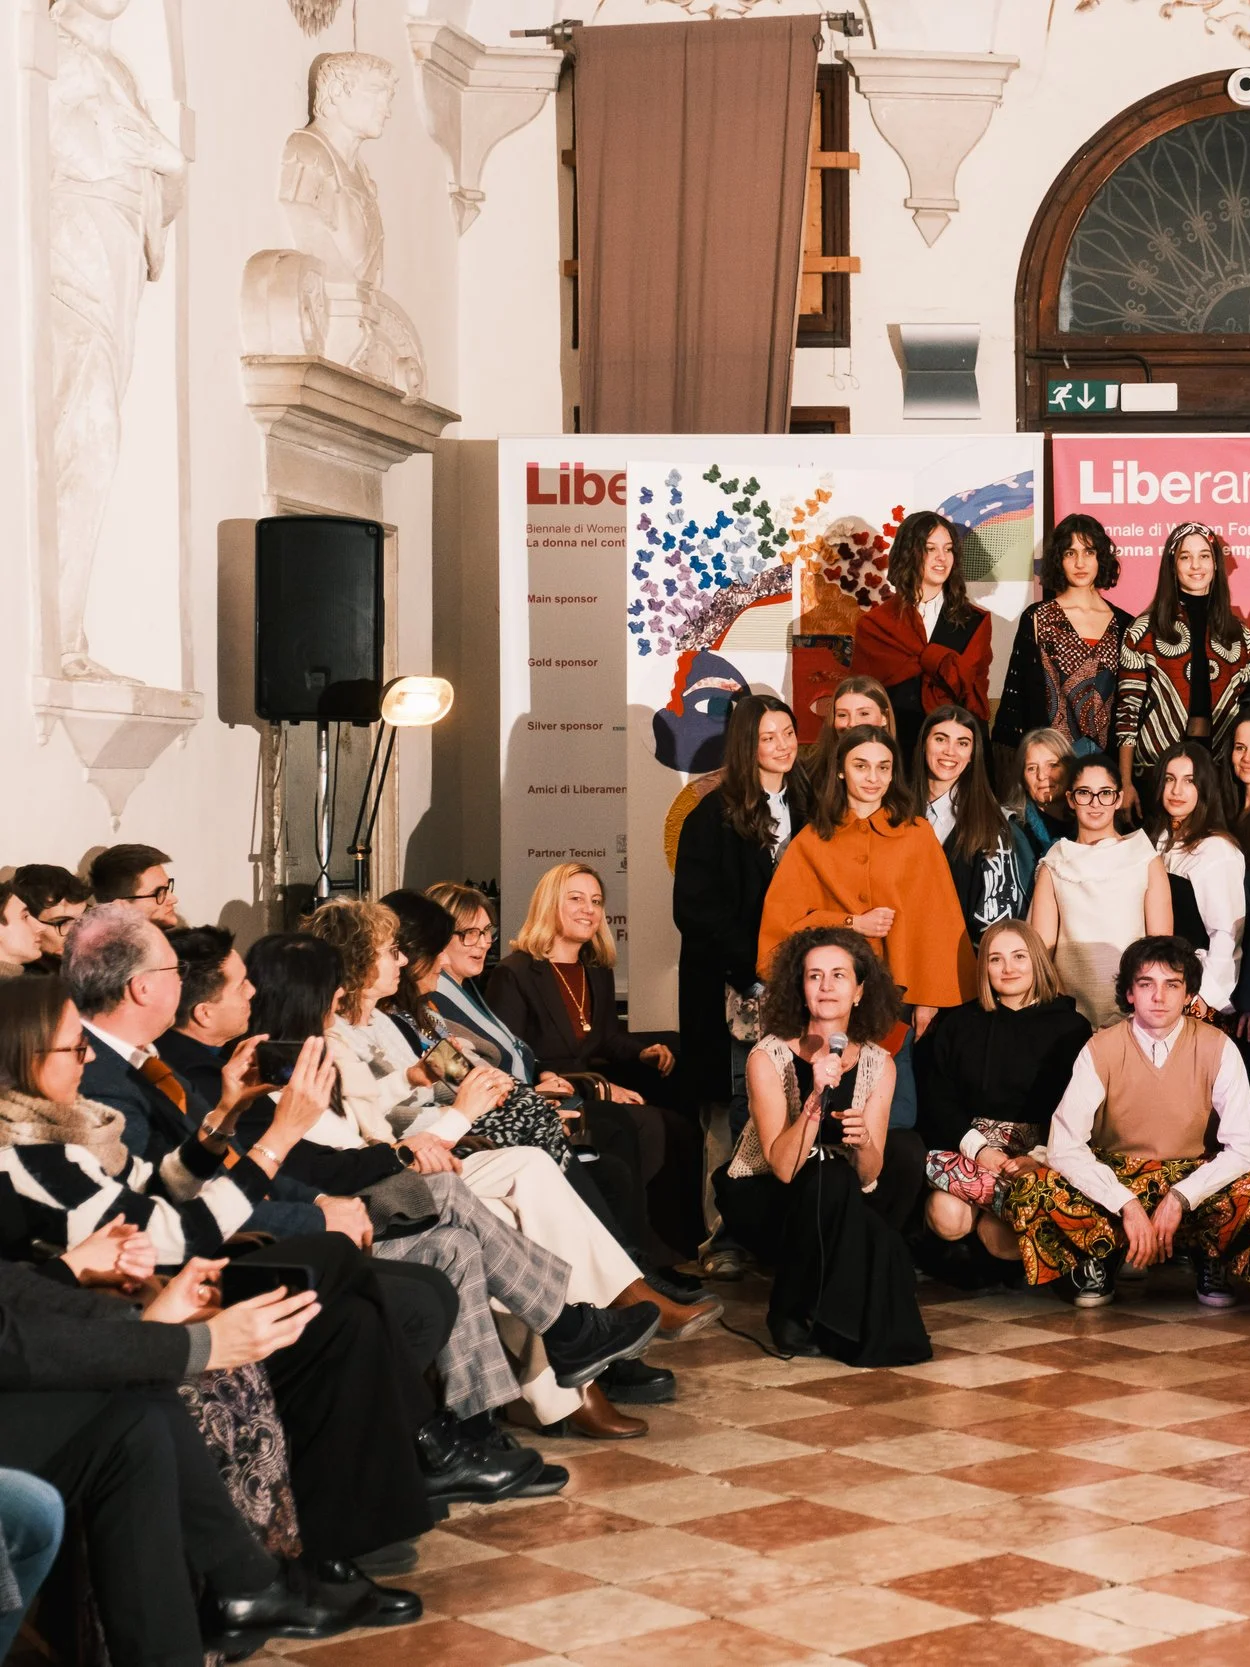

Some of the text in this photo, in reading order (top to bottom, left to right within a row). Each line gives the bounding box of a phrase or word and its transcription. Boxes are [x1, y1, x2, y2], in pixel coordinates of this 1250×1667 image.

[526, 462, 627, 506] Libe
[526, 524, 627, 534] Biennale di Women
[1148, 522, 1162, 537] di
[526, 538, 626, 548] La donna nel cont
[528, 594, 598, 605] Main sponsor
[528, 658, 599, 669] Gold sponsor
[527, 721, 557, 731] Silver
[560, 722, 604, 732] sponsor
[527, 785, 558, 794] Amici
[560, 785, 570, 794] di
[527, 847, 607, 858] Partner Tecnici
